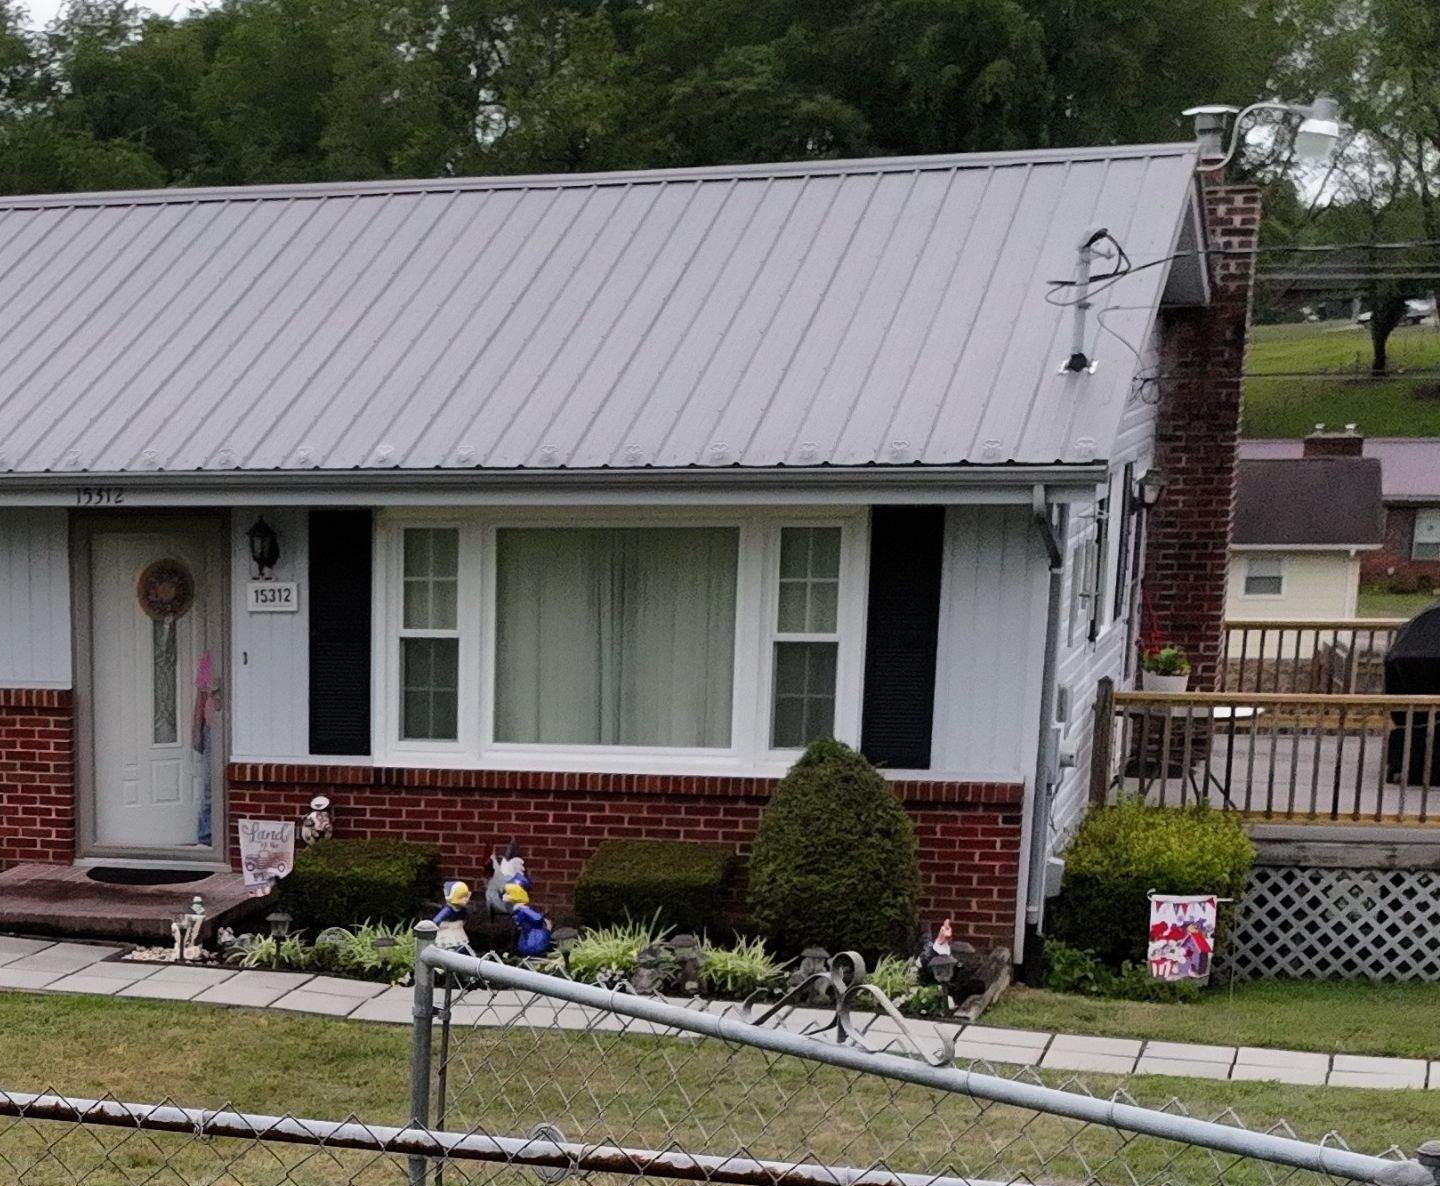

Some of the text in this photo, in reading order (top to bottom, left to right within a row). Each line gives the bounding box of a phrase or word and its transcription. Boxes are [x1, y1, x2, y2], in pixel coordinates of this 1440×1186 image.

[76, 487, 124, 504] 15312
[254, 587, 292, 604] 15312
[242, 822, 289, 843] Land
